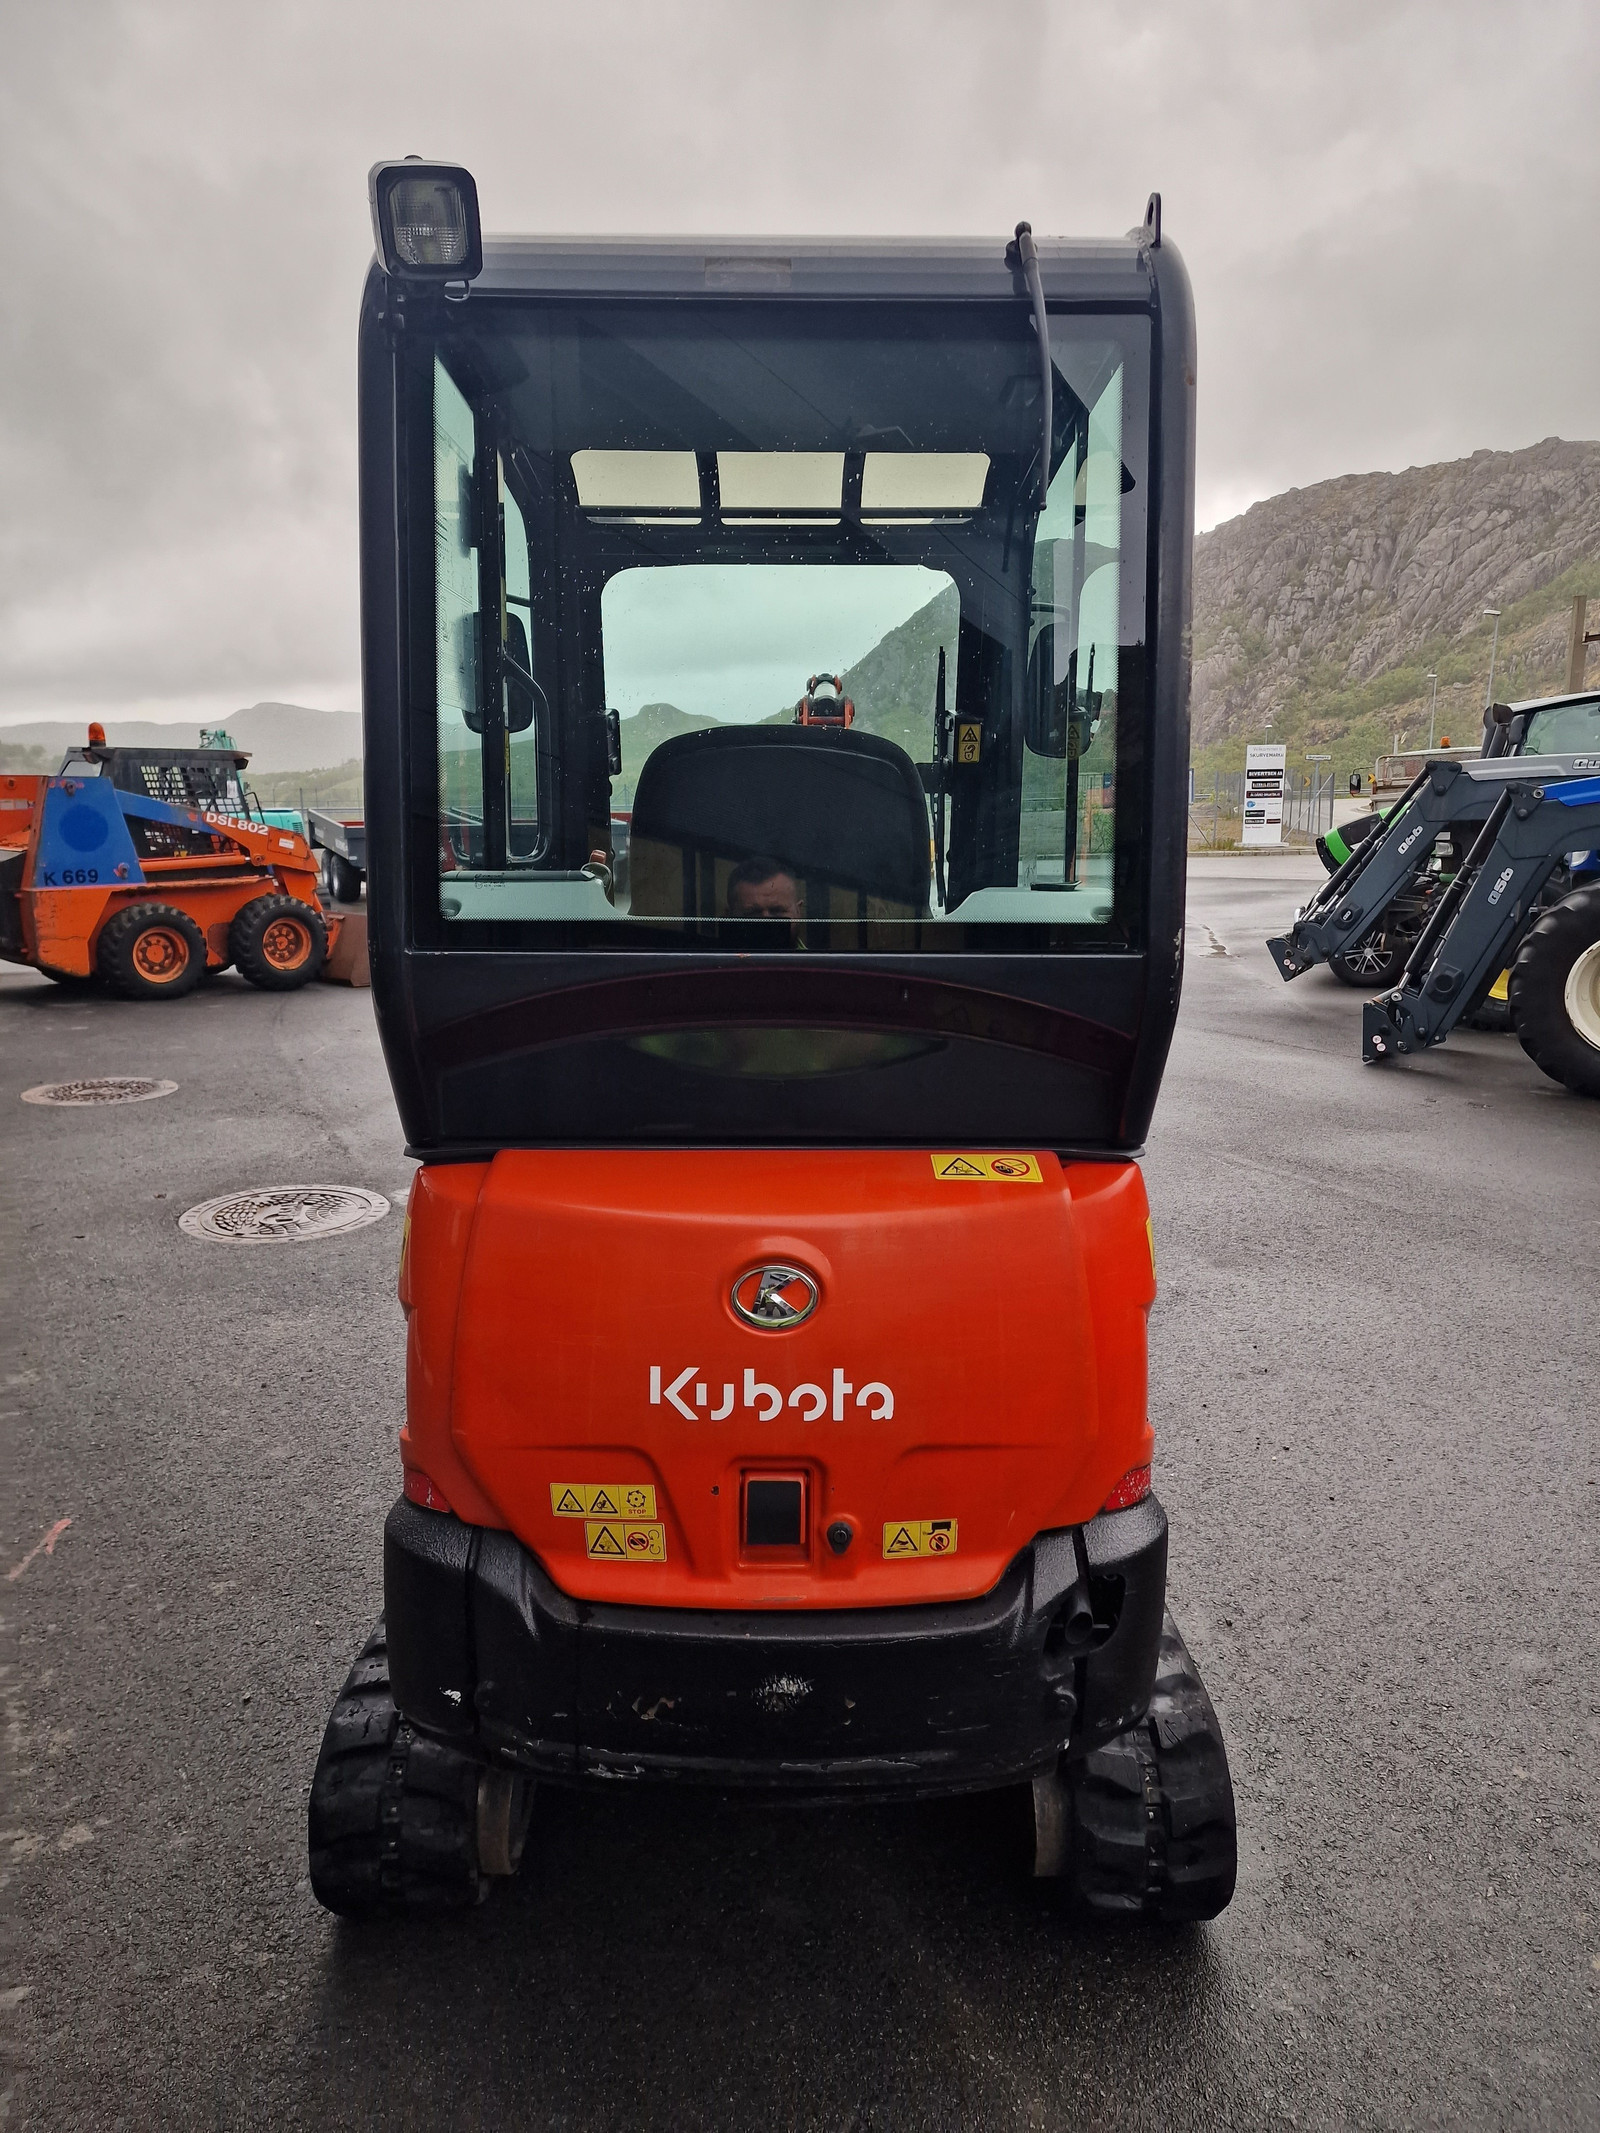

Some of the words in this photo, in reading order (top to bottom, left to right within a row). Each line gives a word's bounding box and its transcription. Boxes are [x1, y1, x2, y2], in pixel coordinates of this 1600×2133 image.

[206, 812, 269, 836] DSL802
[43, 871, 57, 886] K
[62, 869, 99, 884] 669
[649, 1365, 895, 1422] Kubota
